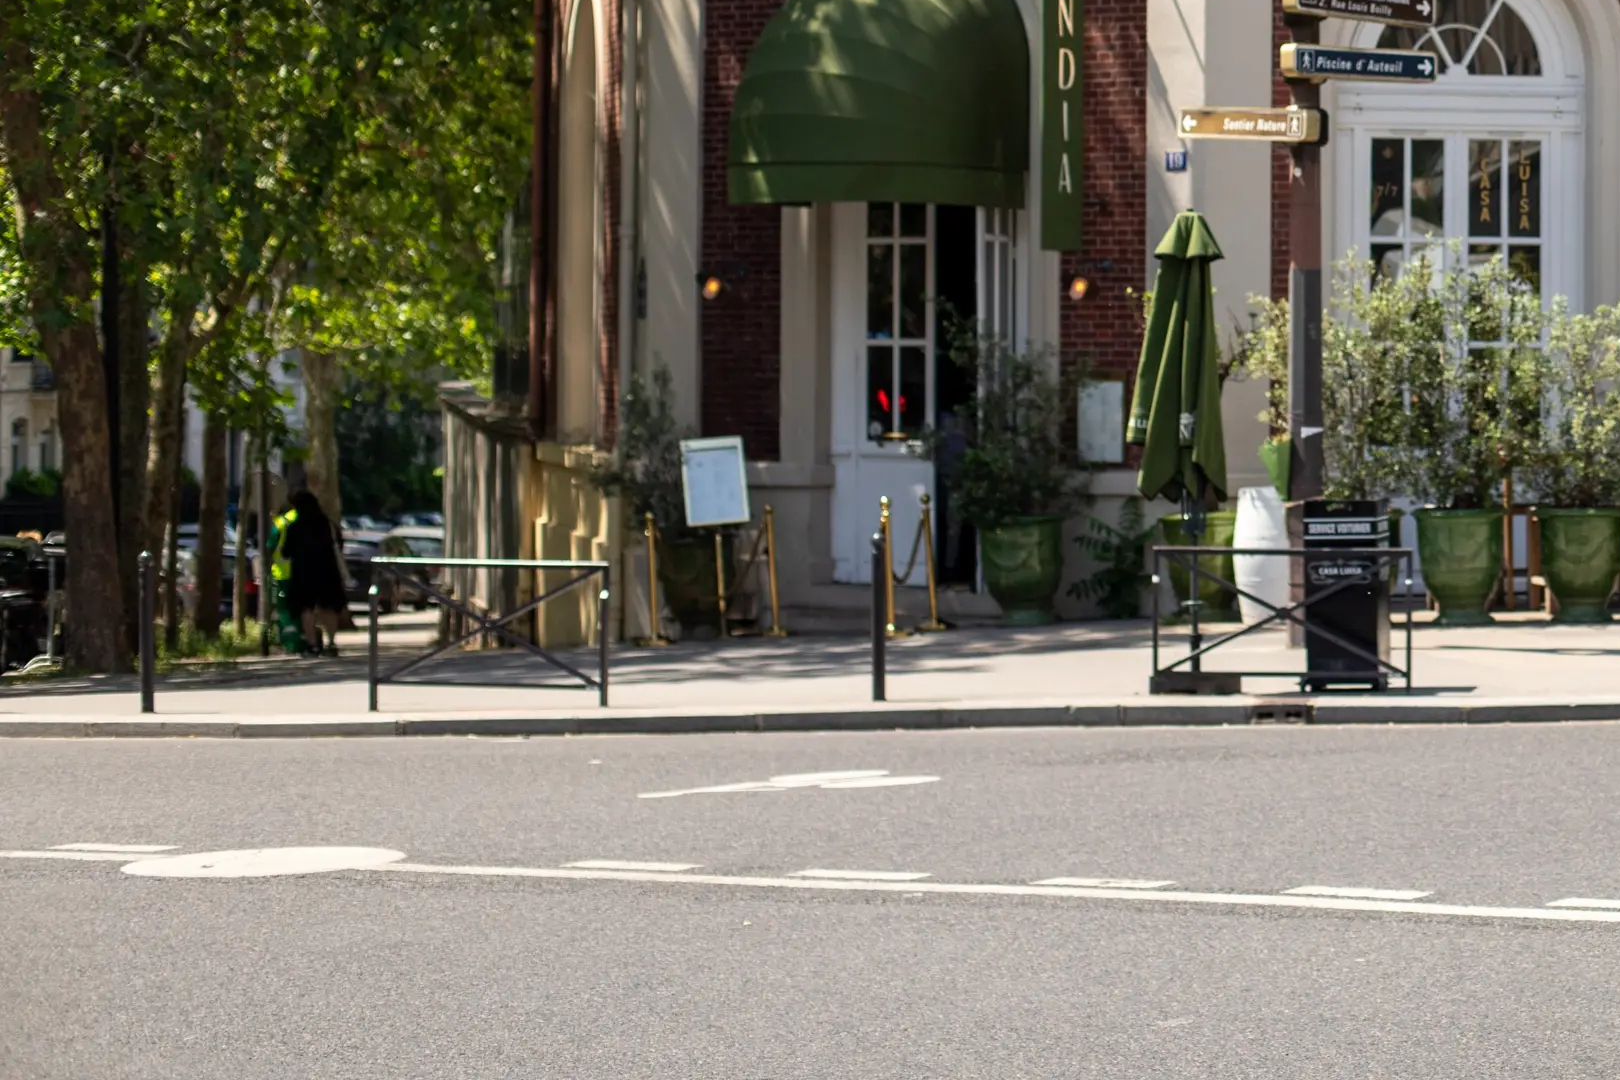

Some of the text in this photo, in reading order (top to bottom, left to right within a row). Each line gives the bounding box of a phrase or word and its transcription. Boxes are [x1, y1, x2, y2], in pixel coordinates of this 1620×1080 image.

[1348, 0, 1368, 12] Louis
[1316, 56, 1352, 71] Piscine
[1223, 117, 1287, 132] Sentier Nature
[1519, 149, 1531, 230] LUISA
[1318, 567, 1338, 575] CASA
